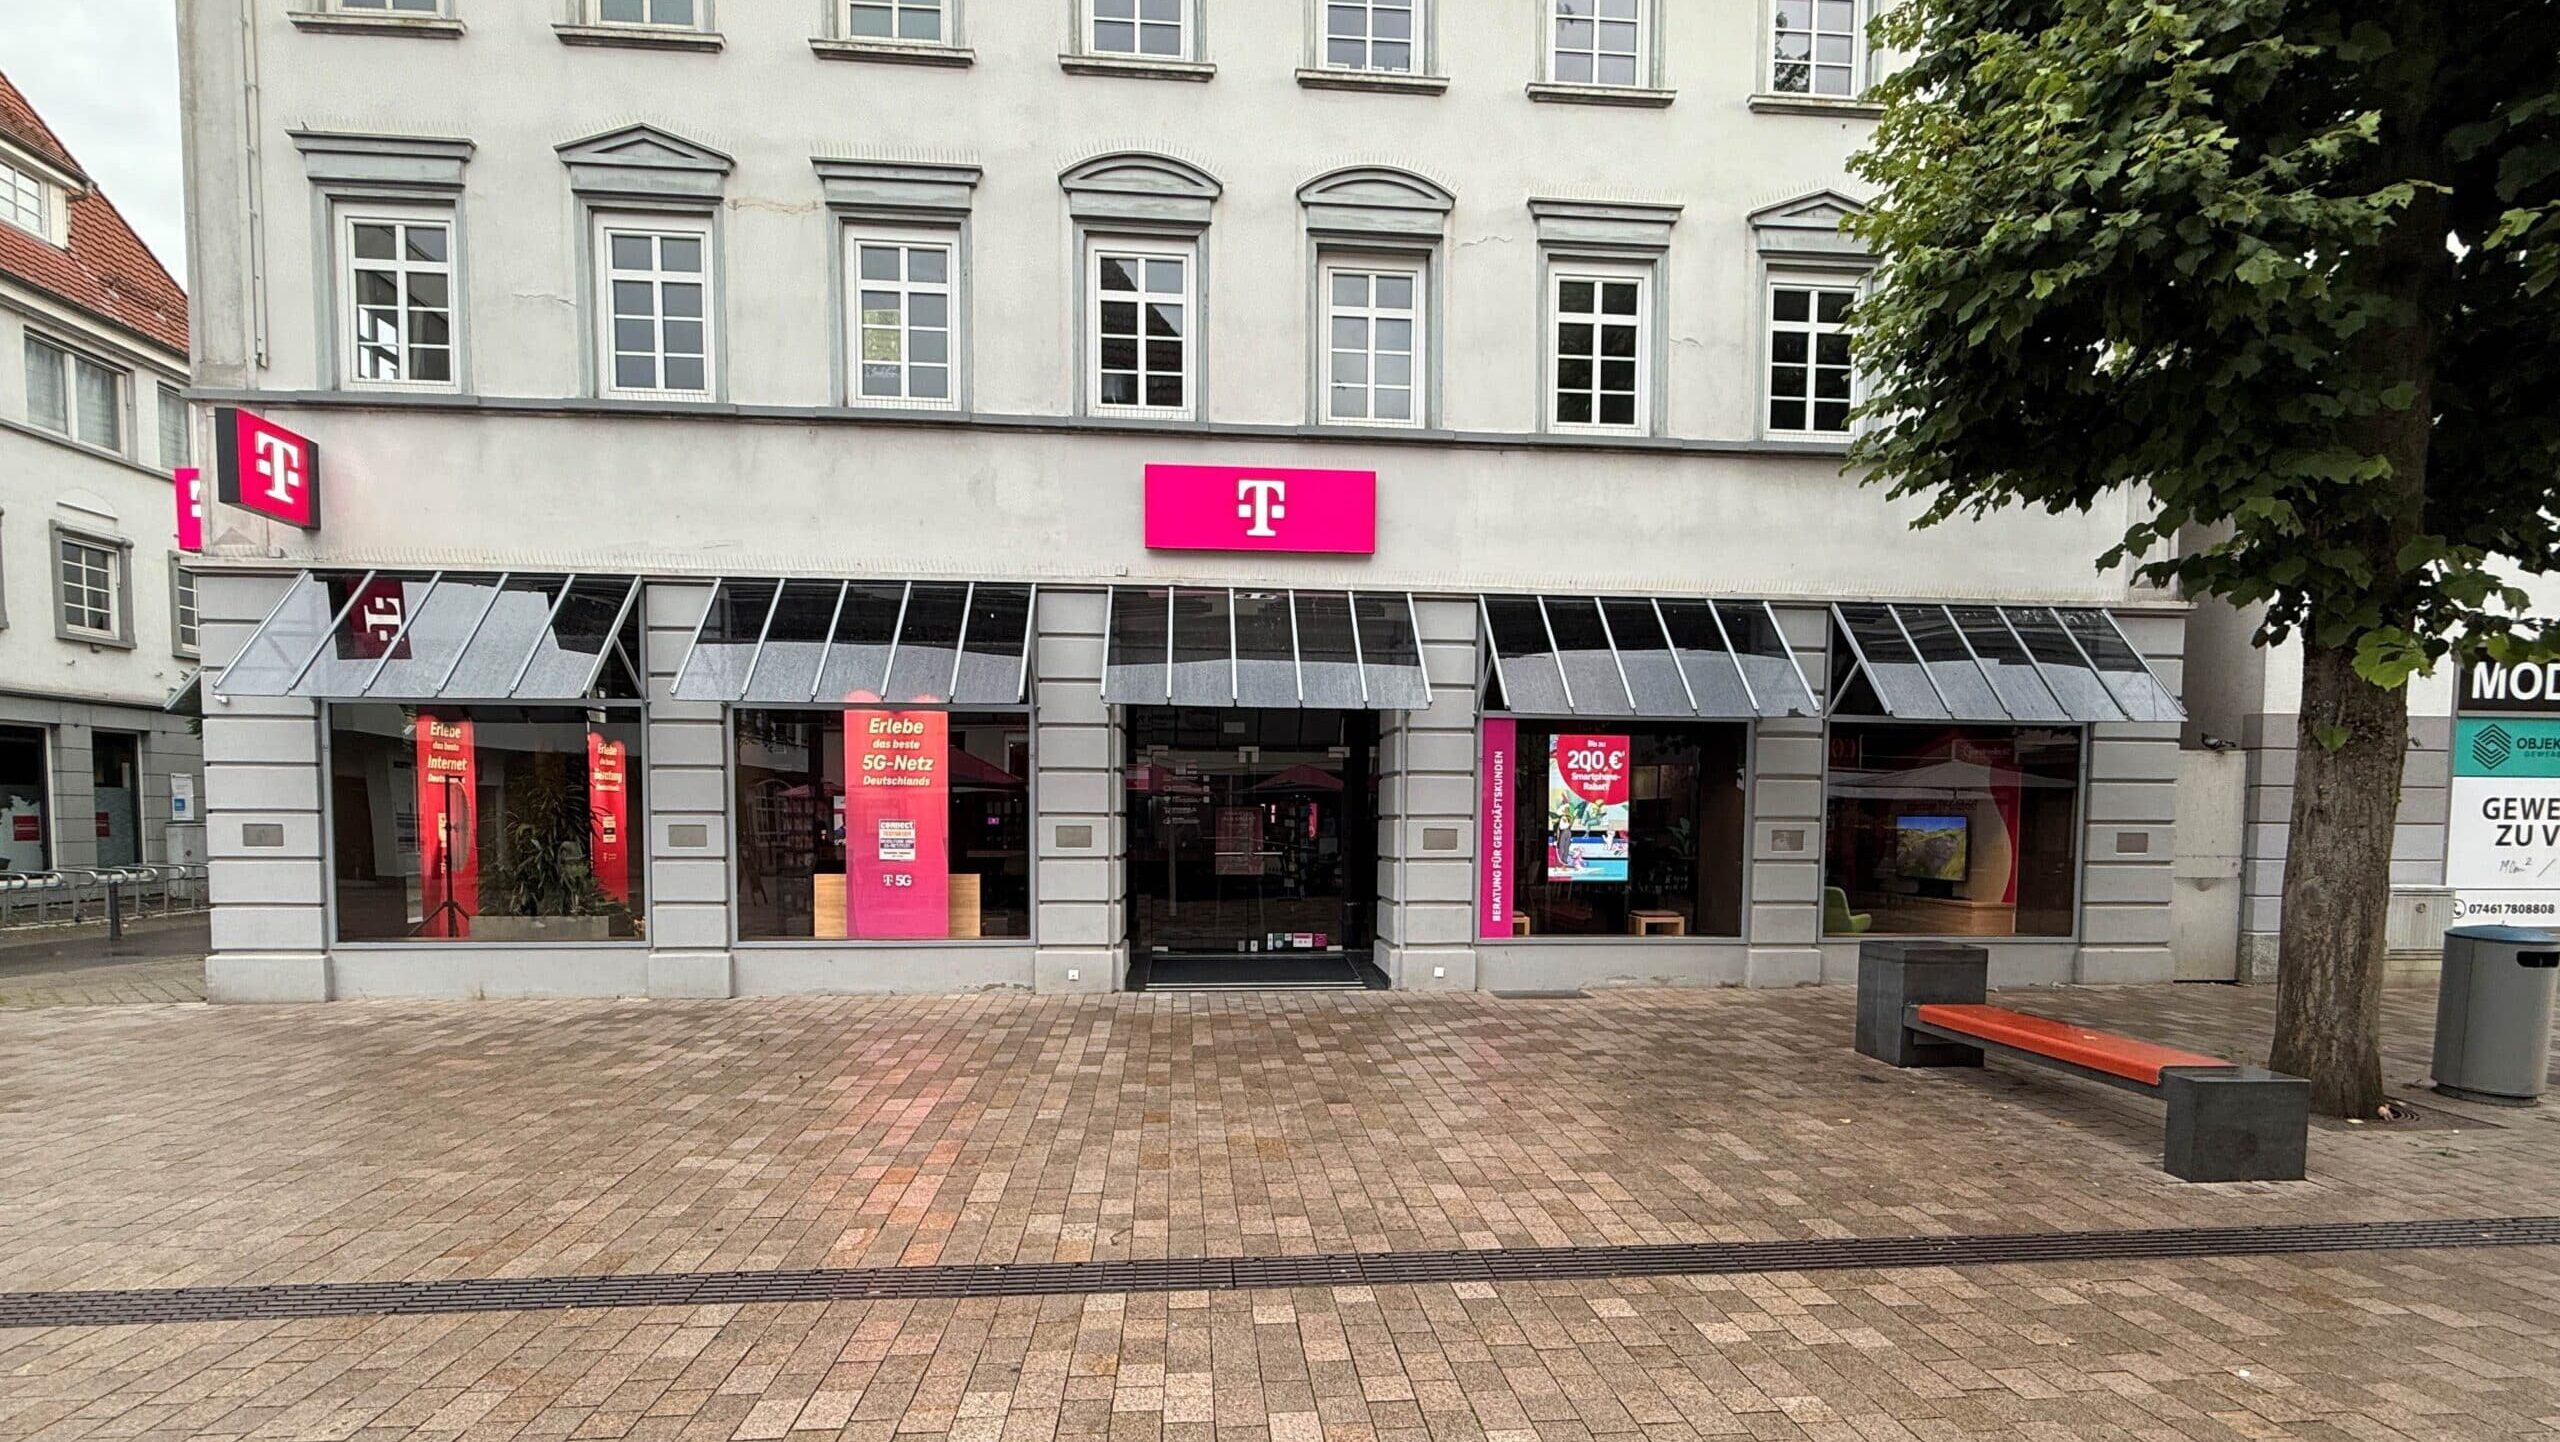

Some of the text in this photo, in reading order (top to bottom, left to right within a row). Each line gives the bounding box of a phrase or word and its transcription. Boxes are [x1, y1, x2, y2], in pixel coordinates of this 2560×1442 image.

[256, 431, 300, 504] T
[1238, 479, 1285, 537] T
[868, 717, 924, 735] Erlebe
[872, 739, 921, 750] das beste
[427, 754, 468, 771] Internet
[862, 754, 935, 771] 5G-Netz
[863, 775, 931, 787] Deutschlands
[2482, 797, 2560, 820] GEWE
[1490, 751, 1503, 922] BERATUNG FÜR GESCHÄFTSKUNDEN
[2495, 824, 2533, 846] ZU
[895, 874, 912, 887] 5G
